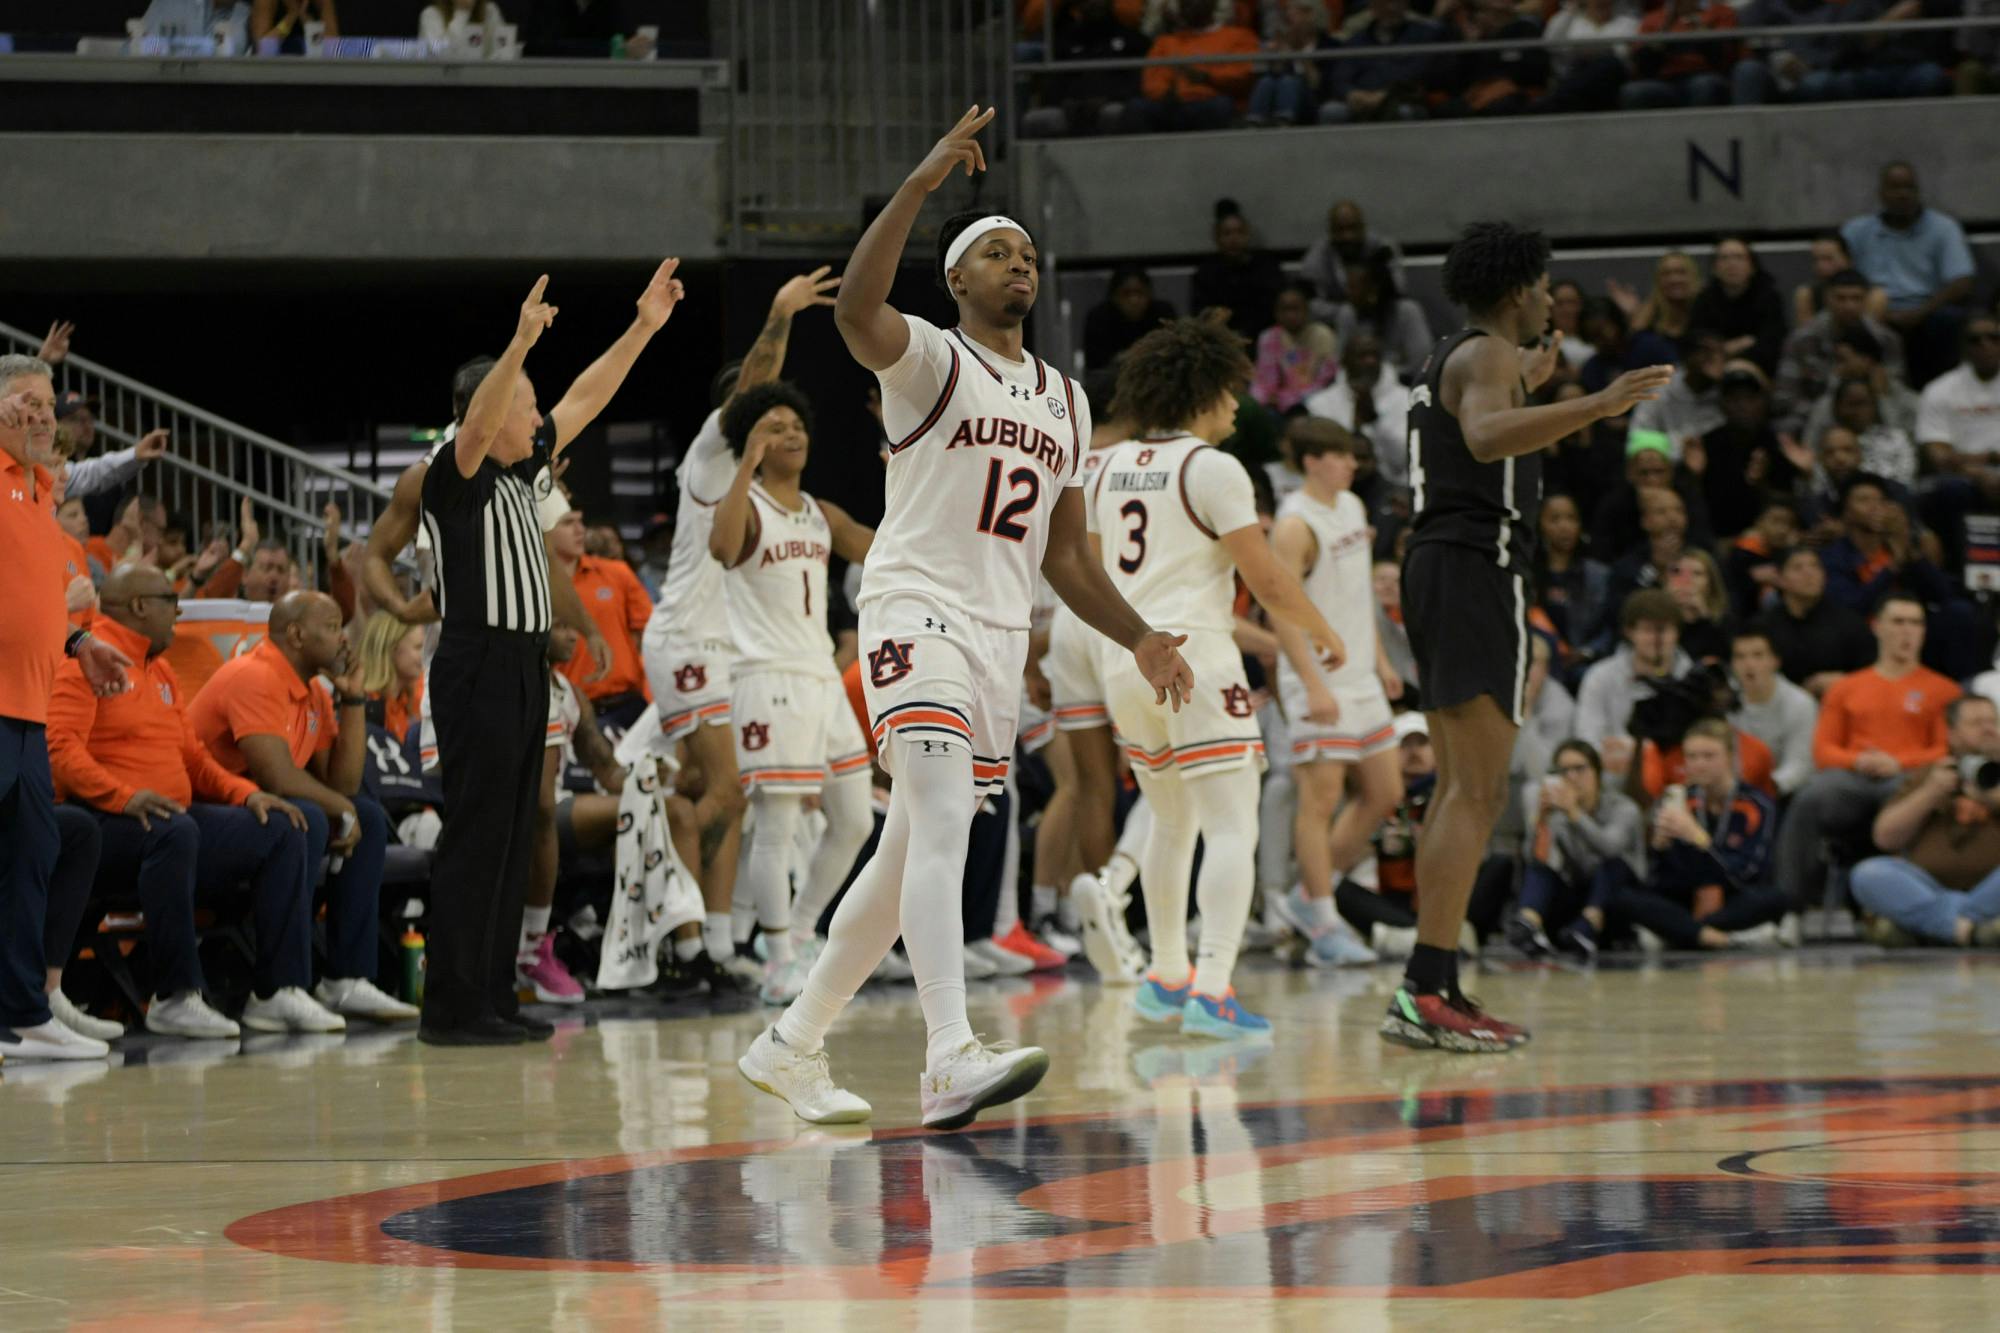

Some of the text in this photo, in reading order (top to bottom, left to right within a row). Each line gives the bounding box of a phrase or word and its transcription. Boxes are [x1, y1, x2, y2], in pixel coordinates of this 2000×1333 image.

[1687, 138, 1741, 202] N
[945, 417, 1067, 480] AUBURN
[976, 456, 1040, 543] 12
[1109, 471, 1170, 492] DONALDSON
[760, 540, 828, 569] AUBUR
[1118, 498, 1148, 575] 3
[802, 569, 811, 617] 1
